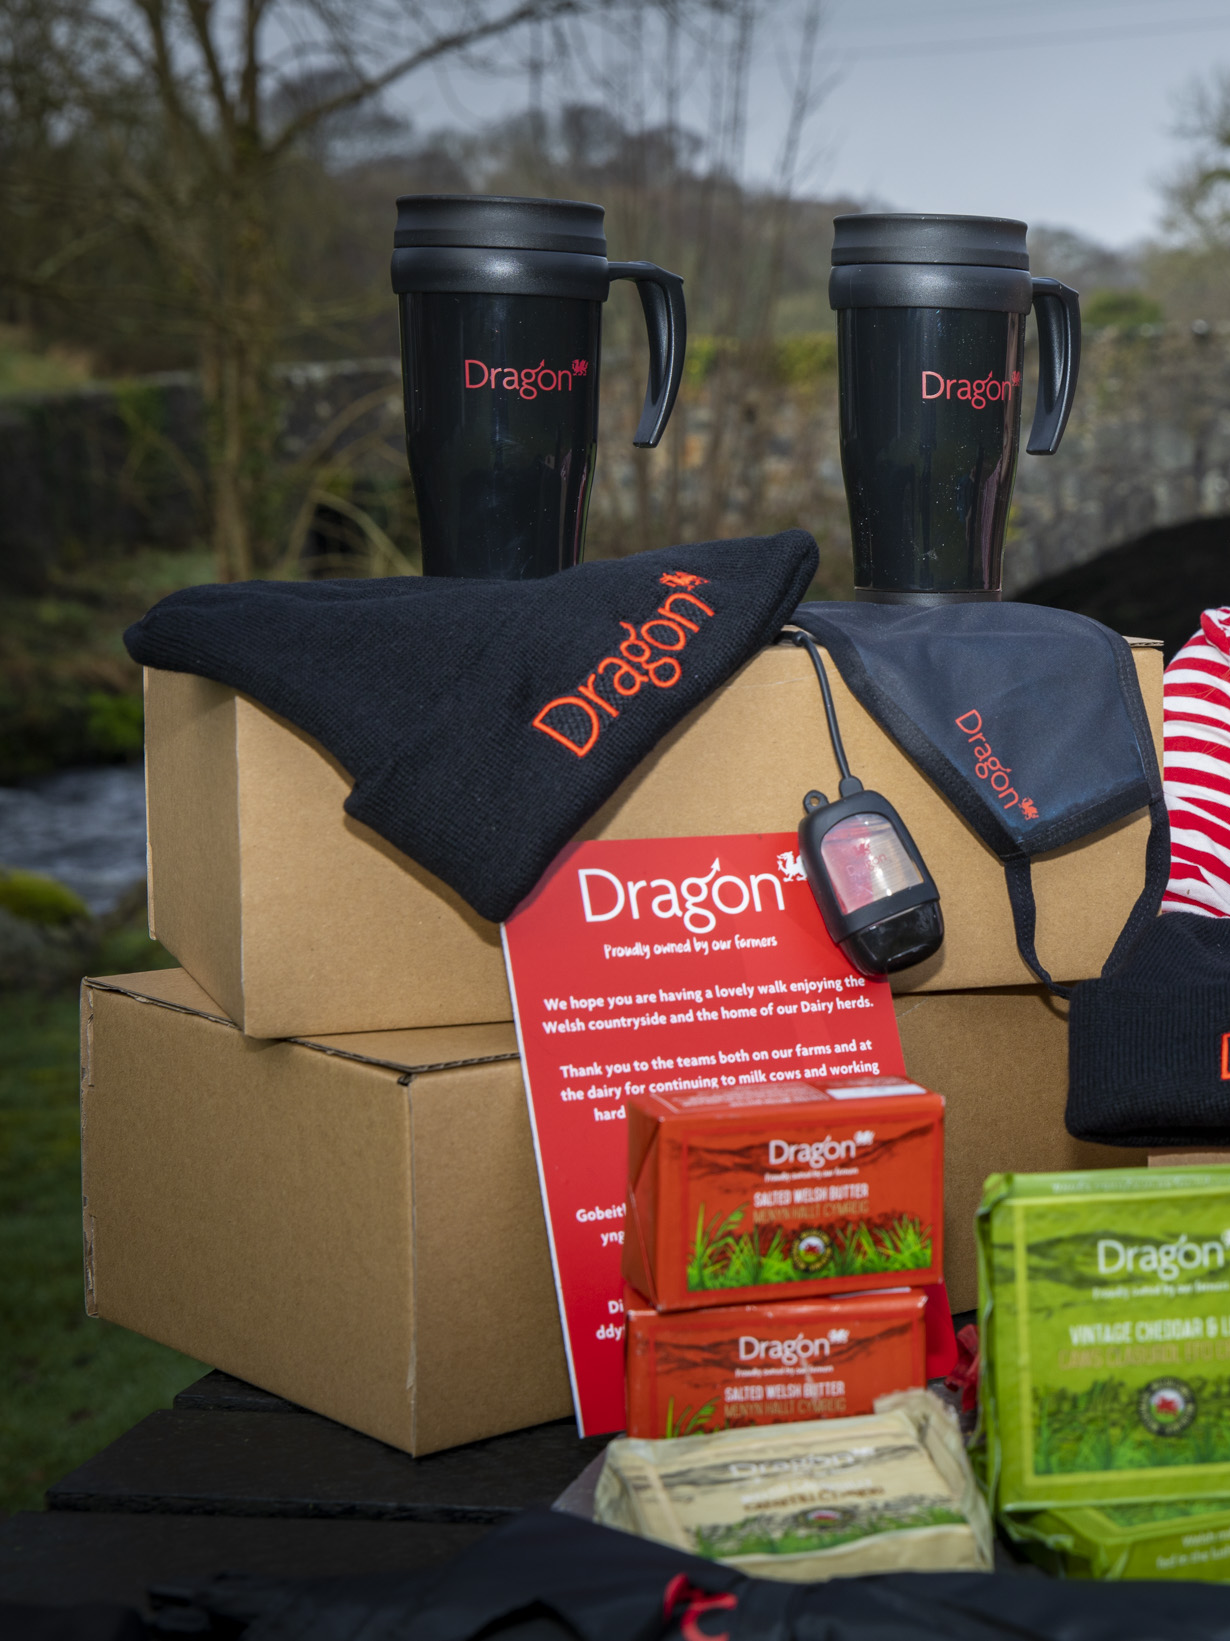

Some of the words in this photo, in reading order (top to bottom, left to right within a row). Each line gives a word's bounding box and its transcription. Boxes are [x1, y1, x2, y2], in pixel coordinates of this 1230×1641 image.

[465, 359, 572, 400] Dragon
[922, 371, 1011, 409] Dragon
[532, 591, 715, 757] Dragon
[954, 709, 1019, 810] Dragon
[578, 857, 785, 934] Dragon
[604, 942, 650, 959] Proudly
[654, 938, 691, 955] owned
[693, 937, 709, 955] by
[712, 938, 732, 951] our
[734, 934, 777, 949] farmers
[543, 998, 567, 1011] We
[569, 996, 604, 1011] hope
[607, 995, 633, 1010] you
[635, 993, 657, 1004] are
[659, 988, 703, 1002] having
[705, 989, 713, 999] a
[715, 983, 754, 998] lovely
[757, 980, 787, 995] walk
[790, 977, 843, 994] enjoying
[844, 975, 865, 988] the
[542, 1018, 585, 1034] Welsh
[588, 1011, 667, 1030] countryside
[669, 1009, 694, 1023] and
[696, 1007, 719, 1021] the
[721, 1006, 757, 1019] home
[760, 1002, 774, 1016] of
[776, 1003, 798, 1015] our
[800, 999, 834, 1014] Dairy
[836, 995, 874, 1010] herds.
[559, 1061, 603, 1079] Thank
[605, 1063, 631, 1078] you
[633, 1060, 649, 1072] to
[651, 1056, 674, 1071] the
[676, 1053, 716, 1068] teams
[718, 1049, 750, 1065] both
[752, 1050, 769, 1061] on
[771, 1048, 793, 1060] our
[795, 1043, 832, 1057] farms
[834, 1039, 857, 1052] and
[859, 1039, 872, 1051] at
[560, 1087, 584, 1101] the
[587, 1084, 622, 1100] dairy
[624, 1081, 646, 1095] for
[648, 1075, 719, 1093] continuing
[720, 1074, 736, 1086] to
[738, 1070, 767, 1084] milk
[769, 1068, 801, 1081] cows
[804, 1064, 827, 1078] and
[829, 1061, 880, 1075] working
[594, 1105, 626, 1121] hard
[769, 1135, 856, 1168] Dragon
[753, 1189, 792, 1208] SALTED
[793, 1186, 828, 1204] WELSH
[829, 1182, 869, 1201] BUTTER
[1097, 1234, 1225, 1281] Dragon
[739, 1332, 830, 1366] Dragon
[1069, 1321, 1133, 1346] VINTAGE
[724, 1385, 763, 1403] SALTED
[766, 1383, 802, 1400] WELSH
[803, 1380, 845, 1399] BUTTER
